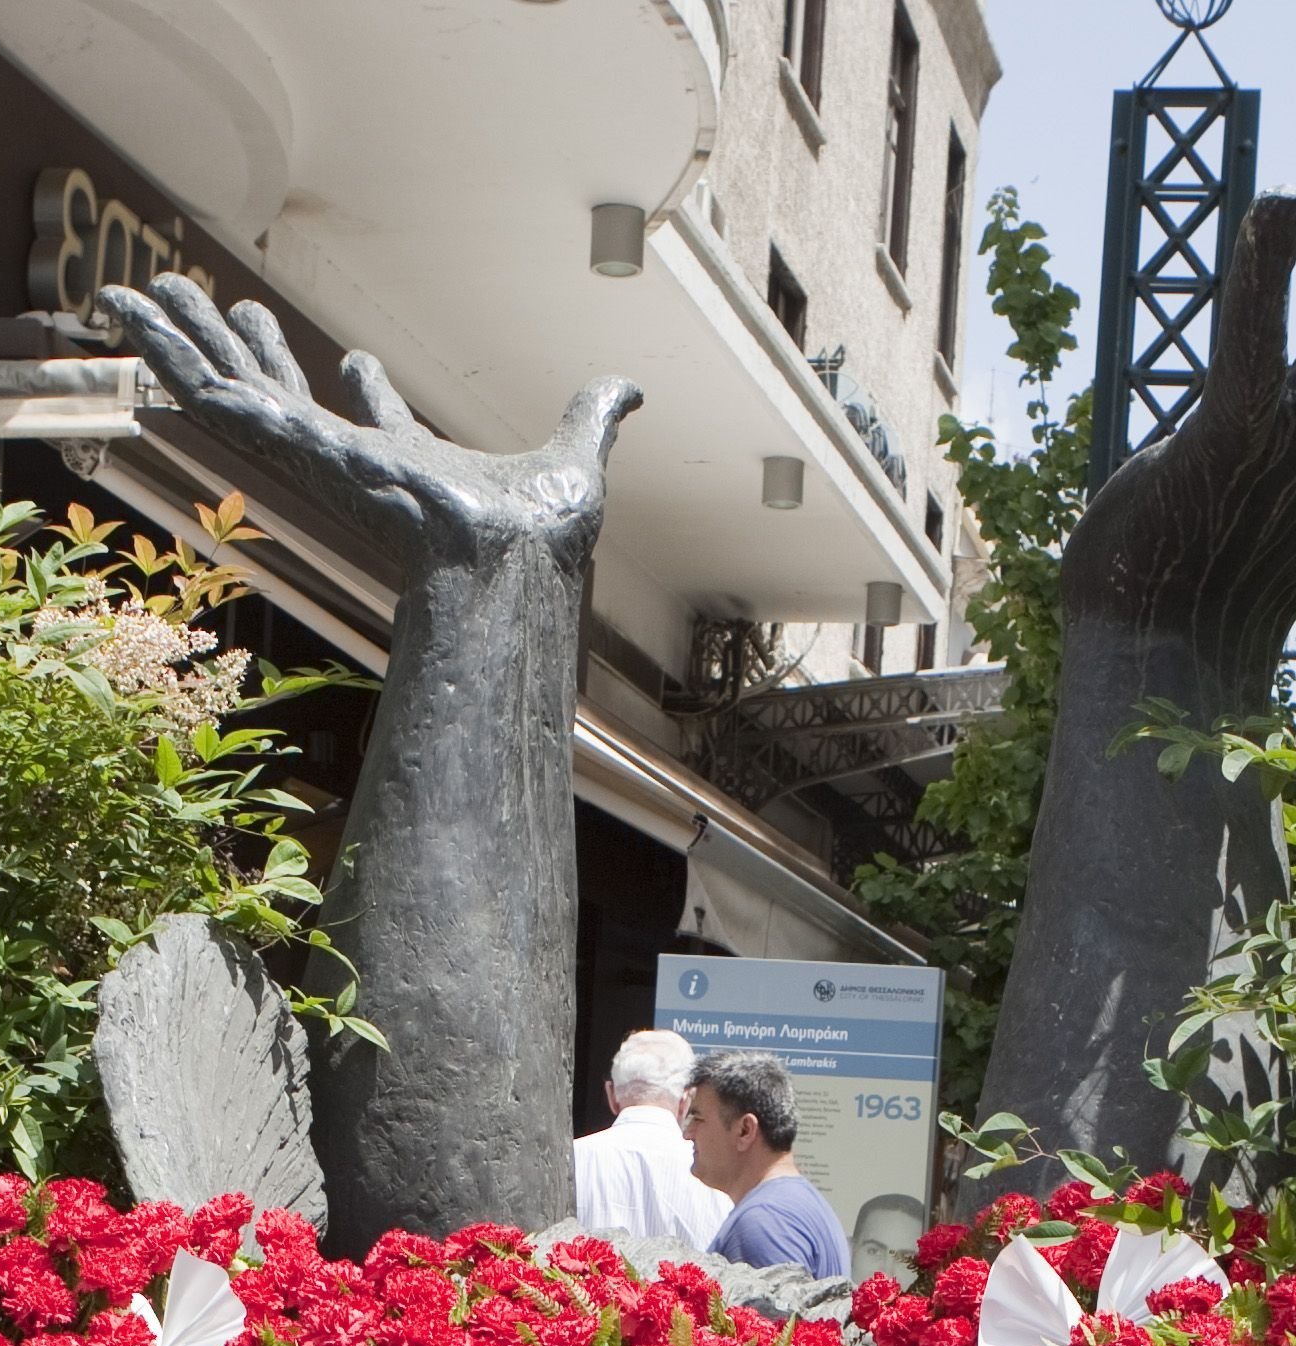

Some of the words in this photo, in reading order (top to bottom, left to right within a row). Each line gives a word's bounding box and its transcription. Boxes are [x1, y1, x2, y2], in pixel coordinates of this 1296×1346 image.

[672, 1018, 720, 1037] Μνήμη
[723, 1020, 777, 1040] Γρηγόρη
[779, 1023, 849, 1043] Λαμπράκη
[784, 1055, 838, 1070] Lambrakis
[854, 1093, 922, 1121] 1963
